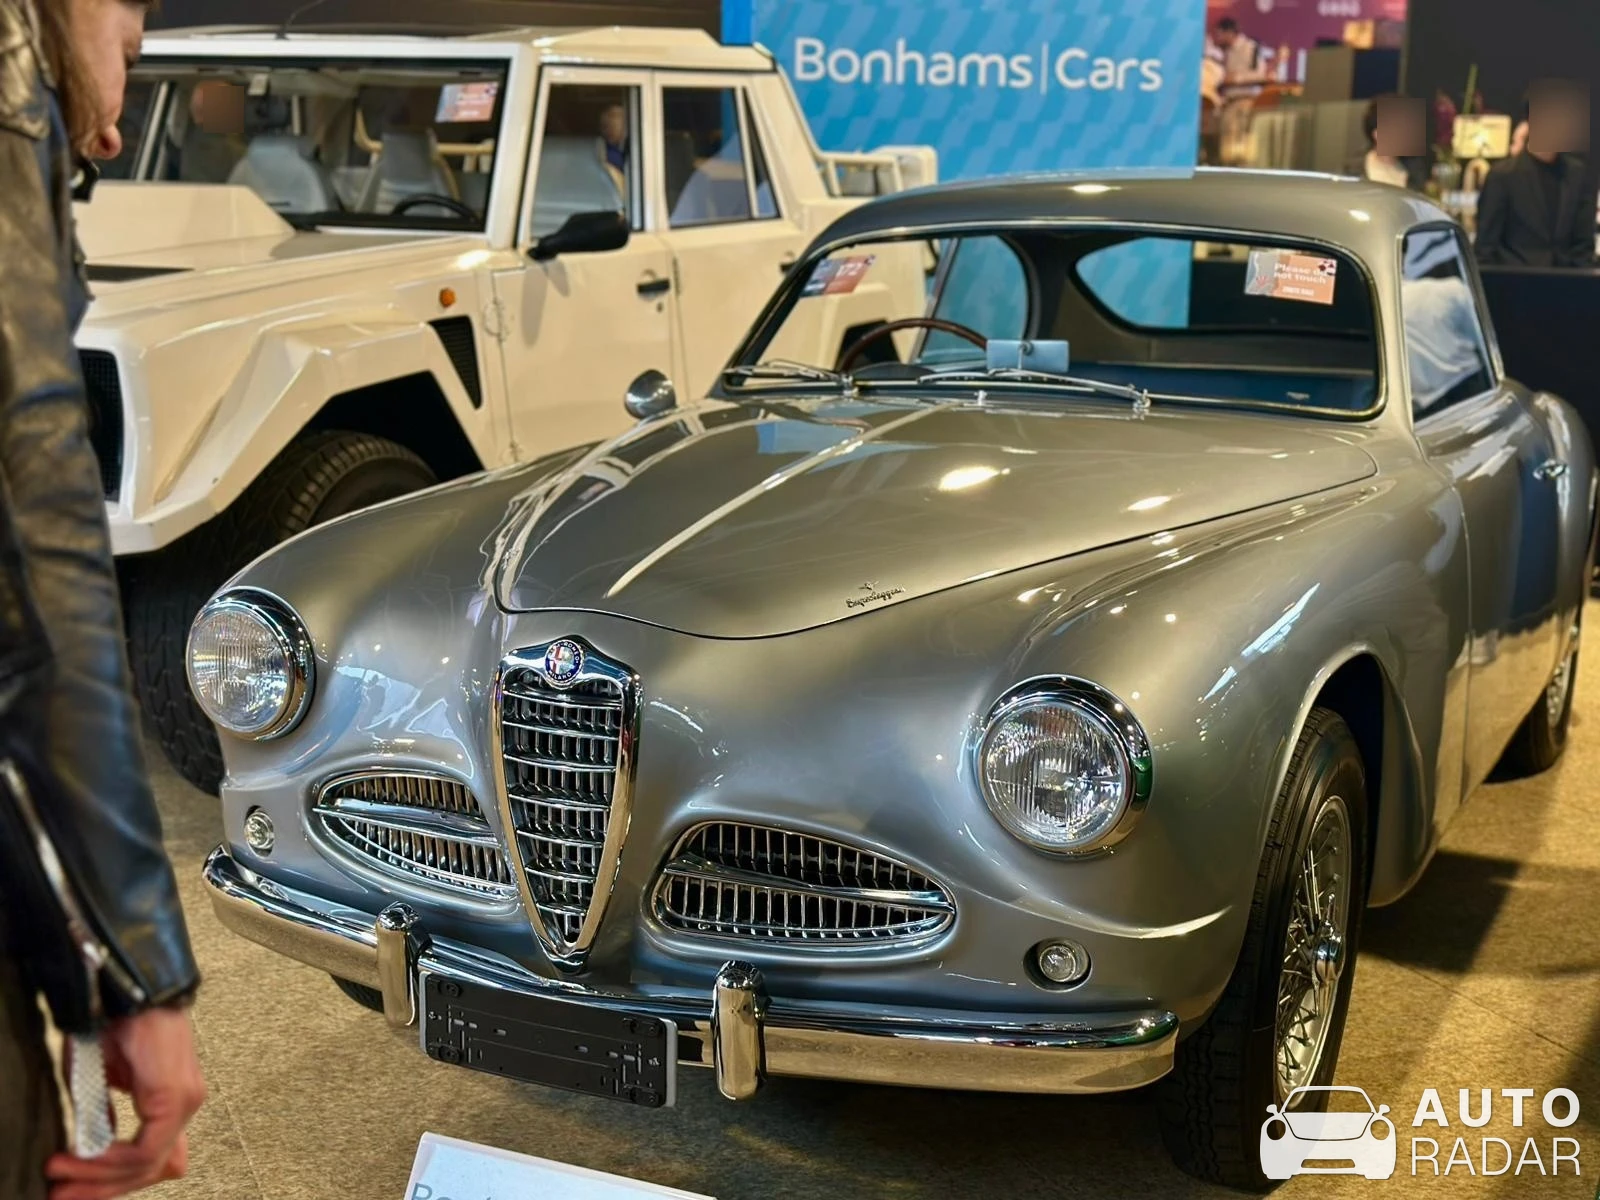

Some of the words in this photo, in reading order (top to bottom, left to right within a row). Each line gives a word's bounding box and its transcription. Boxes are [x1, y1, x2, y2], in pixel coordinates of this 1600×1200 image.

[793, 37, 1034, 89] Bonhams
[1054, 47, 1164, 92] Cars
[1273, 262, 1311, 275] Please
[1273, 270, 1292, 281] not
[1295, 272, 1327, 285] touch
